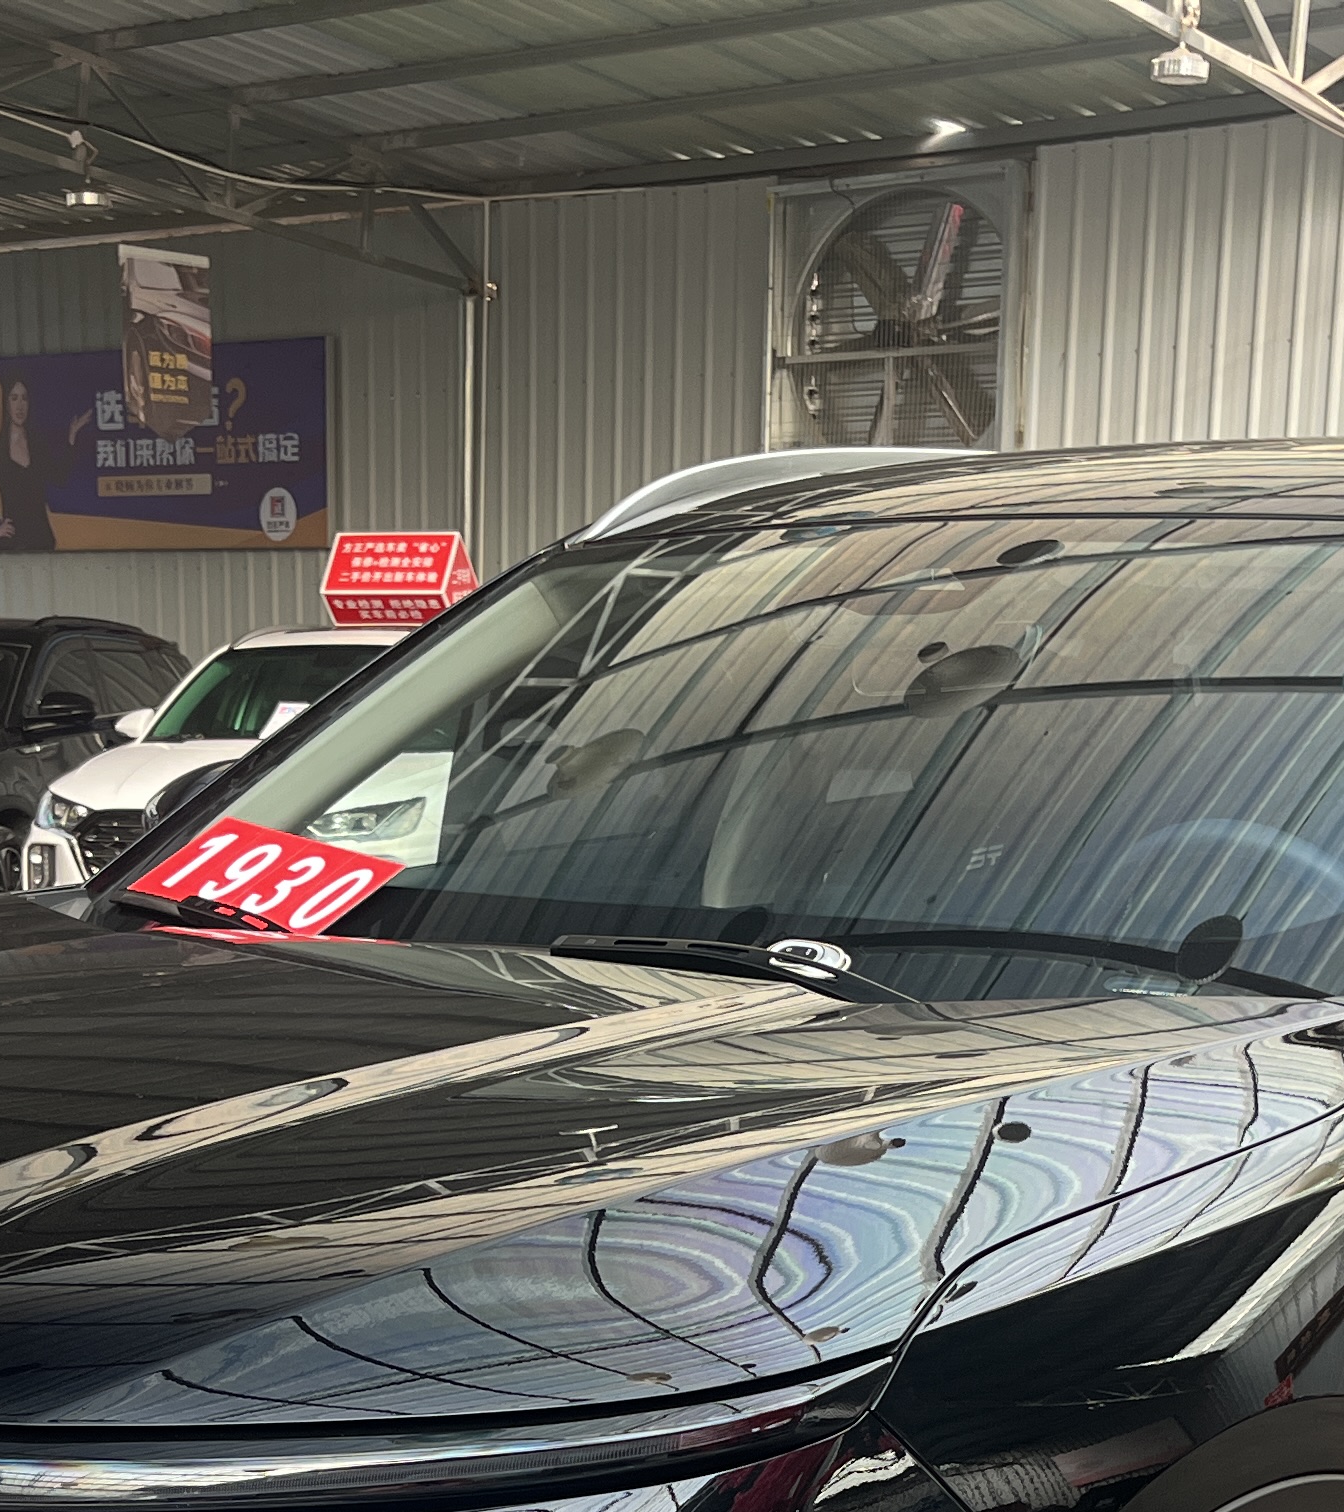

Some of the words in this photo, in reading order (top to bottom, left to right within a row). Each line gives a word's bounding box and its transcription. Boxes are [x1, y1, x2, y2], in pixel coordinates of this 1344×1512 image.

[96, 432, 300, 467] 我们来帮你一站式搞定
[162, 832, 375, 930] 1930
